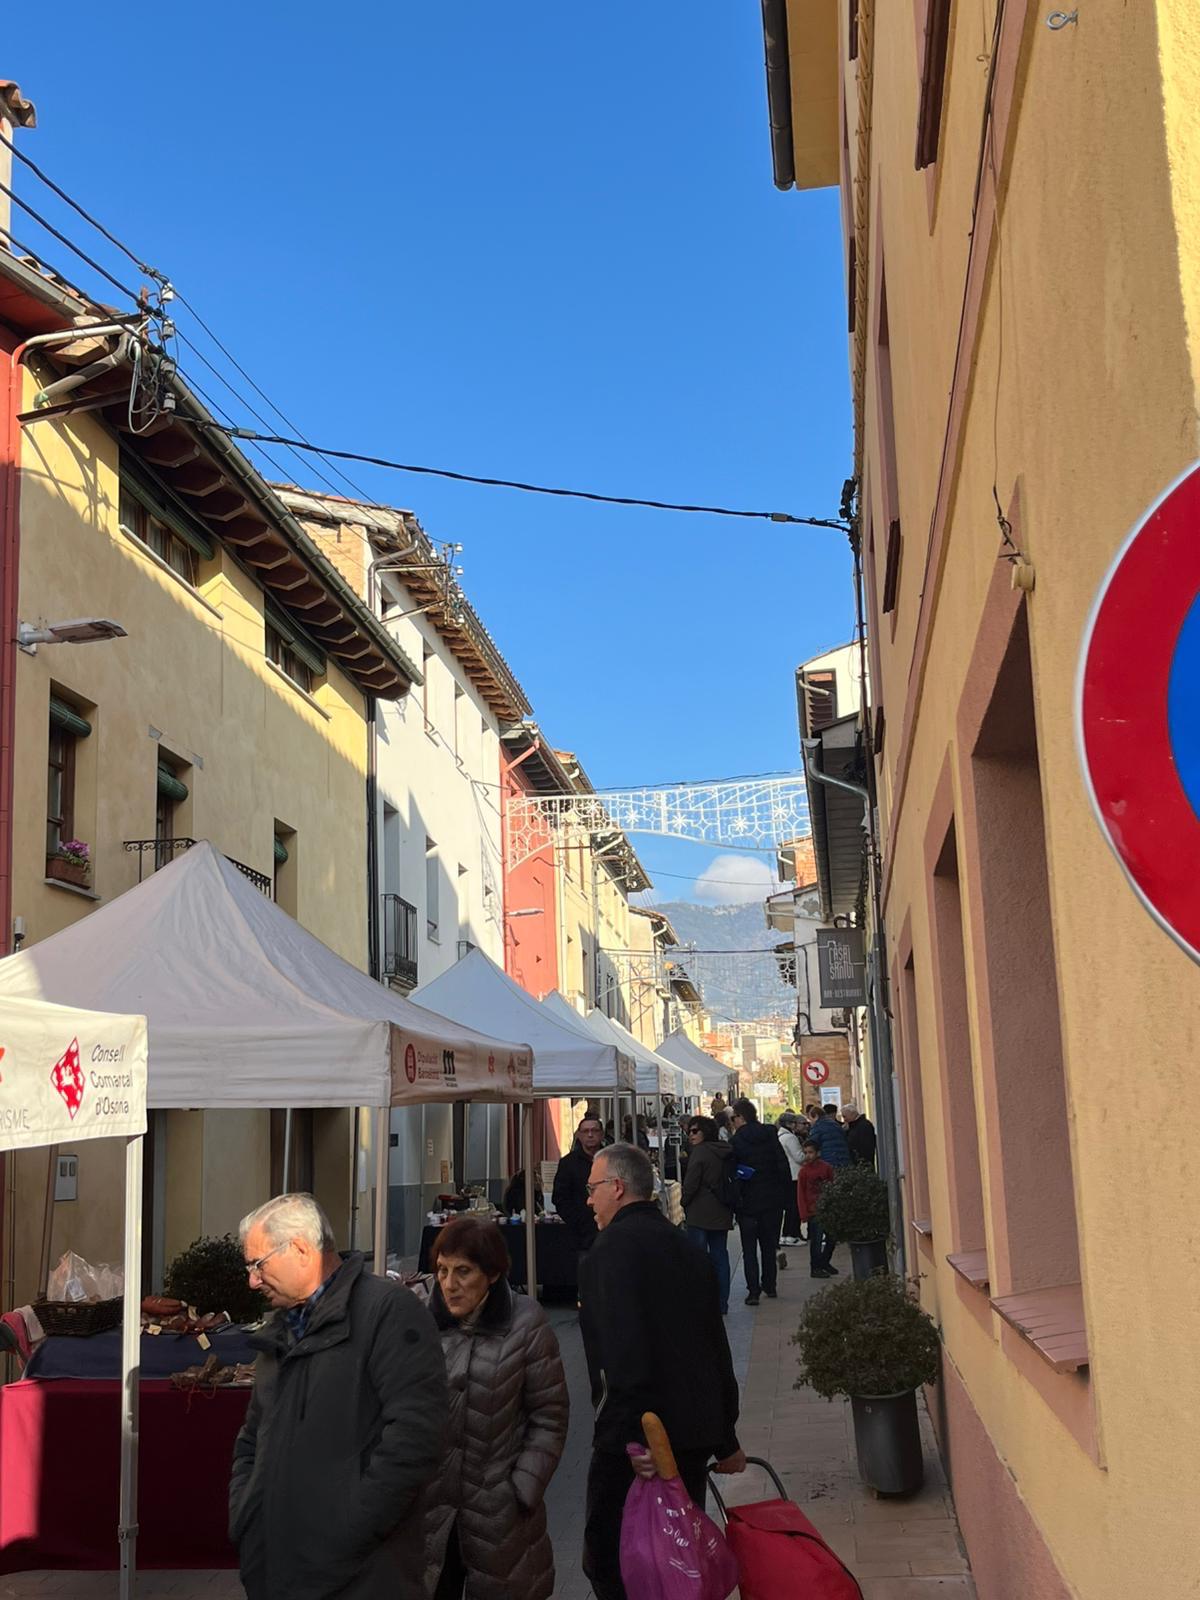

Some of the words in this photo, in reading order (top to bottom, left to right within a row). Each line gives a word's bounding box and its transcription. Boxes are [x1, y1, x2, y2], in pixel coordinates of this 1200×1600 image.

[91, 1044, 125, 1062] Consell
[90, 1069, 133, 1088] Comarcal
[95, 1096, 129, 1115] d'Osona
